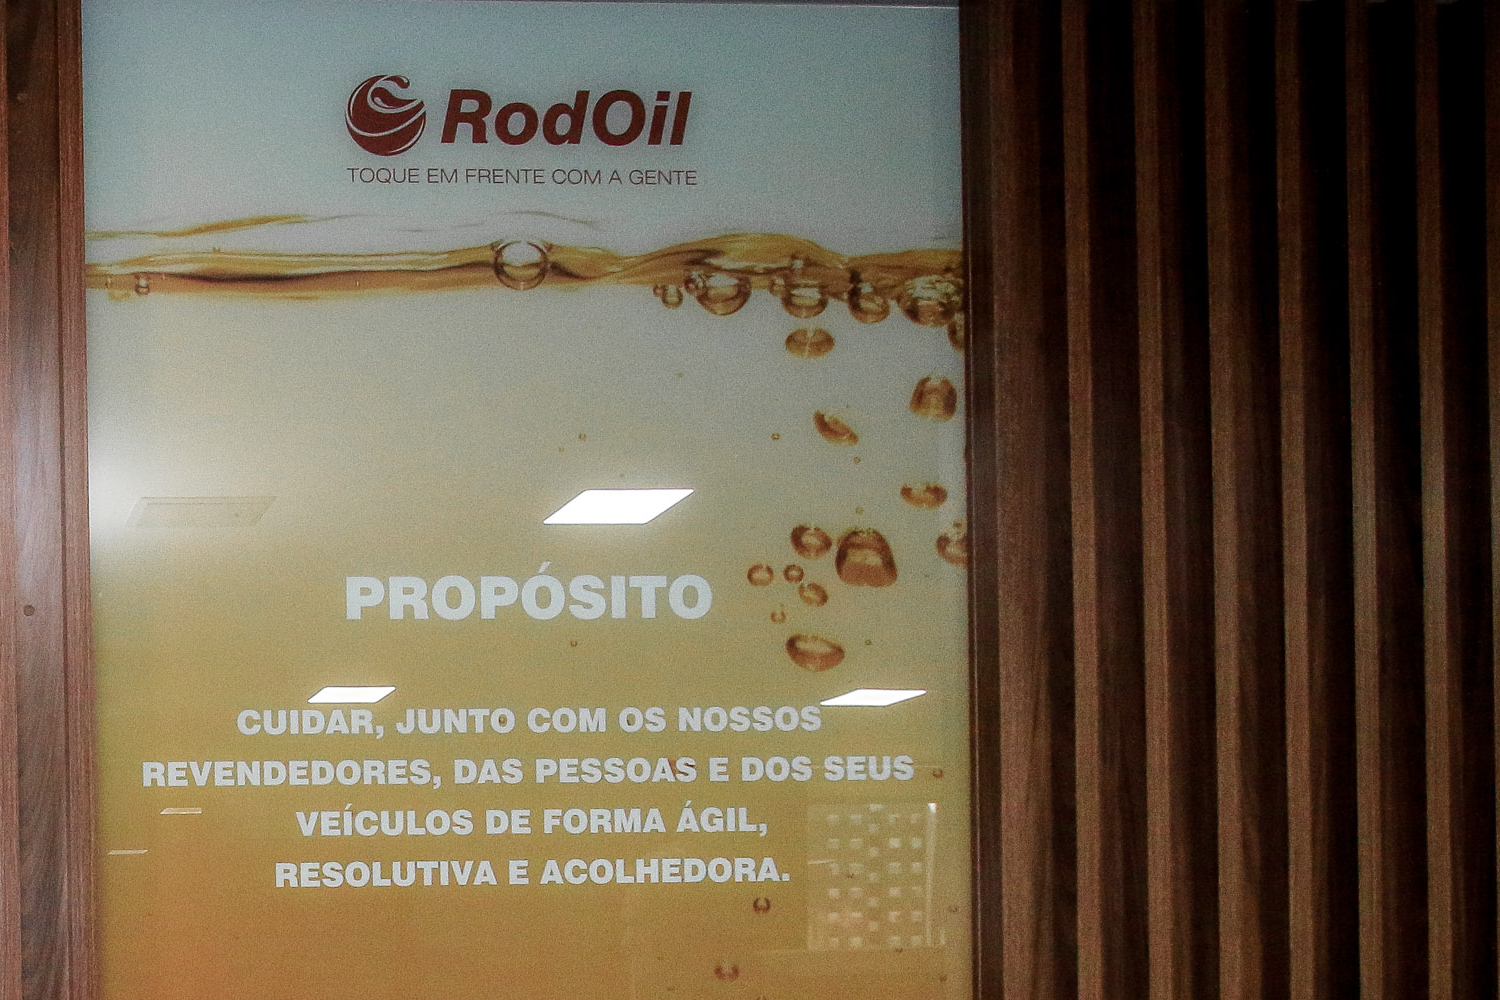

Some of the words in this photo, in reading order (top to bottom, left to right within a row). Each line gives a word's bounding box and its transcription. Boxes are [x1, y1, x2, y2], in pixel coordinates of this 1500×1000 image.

[441, 89, 692, 146] RodOil
[347, 168, 419, 184] TOQUE
[427, 168, 458, 183] EM
[466, 169, 545, 184] FRENTE
[552, 169, 601, 185] COM
[608, 170, 622, 184] A
[629, 169, 697, 185] GENTE
[346, 562, 712, 620] PROPÓSITO
[237, 709, 384, 738] CUIDAR,
[396, 708, 515, 734] JUNTO
[528, 708, 606, 733] COM
[619, 707, 666, 732] OS
[679, 705, 823, 732] NOSSOS
[143, 759, 441, 789] REVENDEDORES,
[455, 759, 523, 783] DAS
[536, 757, 697, 783] PESSOAS
[709, 757, 729, 781] E
[741, 756, 812, 781] DOS
[824, 756, 913, 781] SEUS
[296, 804, 473, 836] VEÍCULOS
[486, 810, 531, 834] DE
[544, 809, 666, 833] FORMA
[677, 800, 767, 836] ÁGIL,
[276, 861, 497, 887] RESOLUTIVA
[509, 860, 529, 884] E
[540, 858, 789, 884] ACOLHEDORA.
